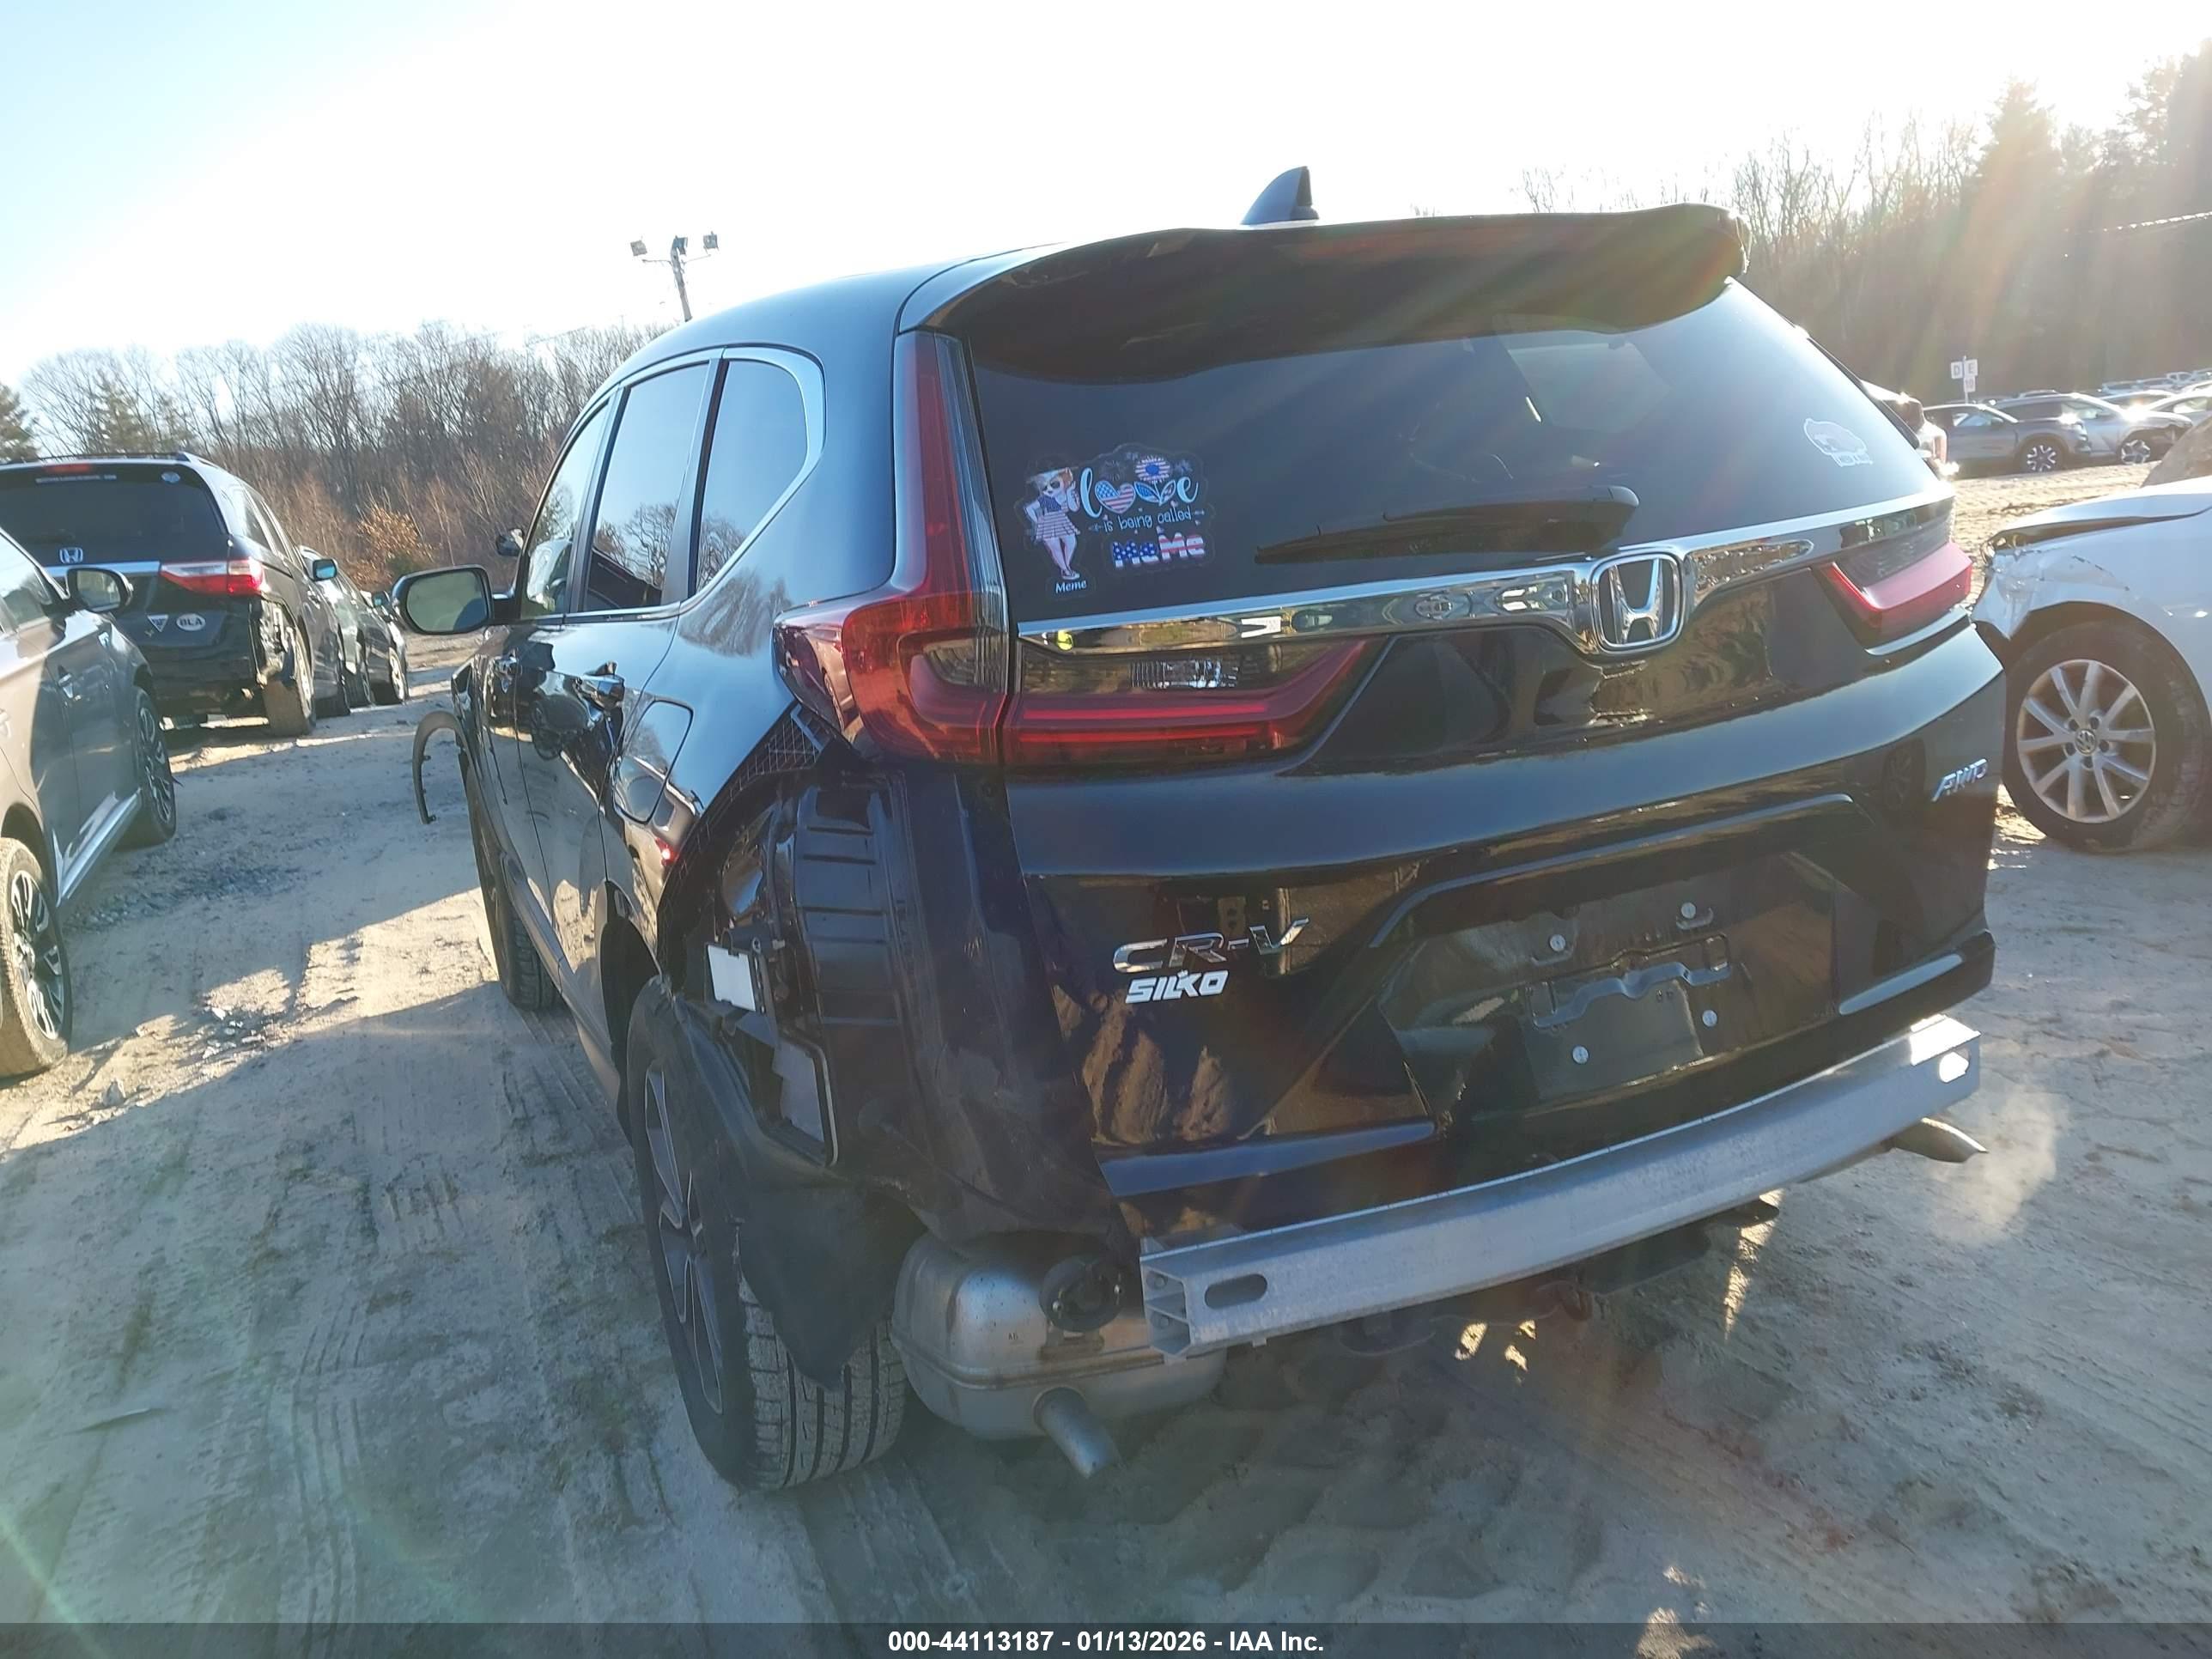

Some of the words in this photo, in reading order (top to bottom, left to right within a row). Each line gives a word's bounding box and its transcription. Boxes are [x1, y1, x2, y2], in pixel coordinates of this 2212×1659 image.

[1103, 520, 1114, 532] is
[1117, 514, 1153, 530] being
[1157, 505, 1192, 525] called
[1054, 580, 1087, 593] Meme
[1930, 757, 1989, 802] AWD
[1113, 917, 1310, 974] CR-V
[1125, 970, 1229, 1004] SILKO
